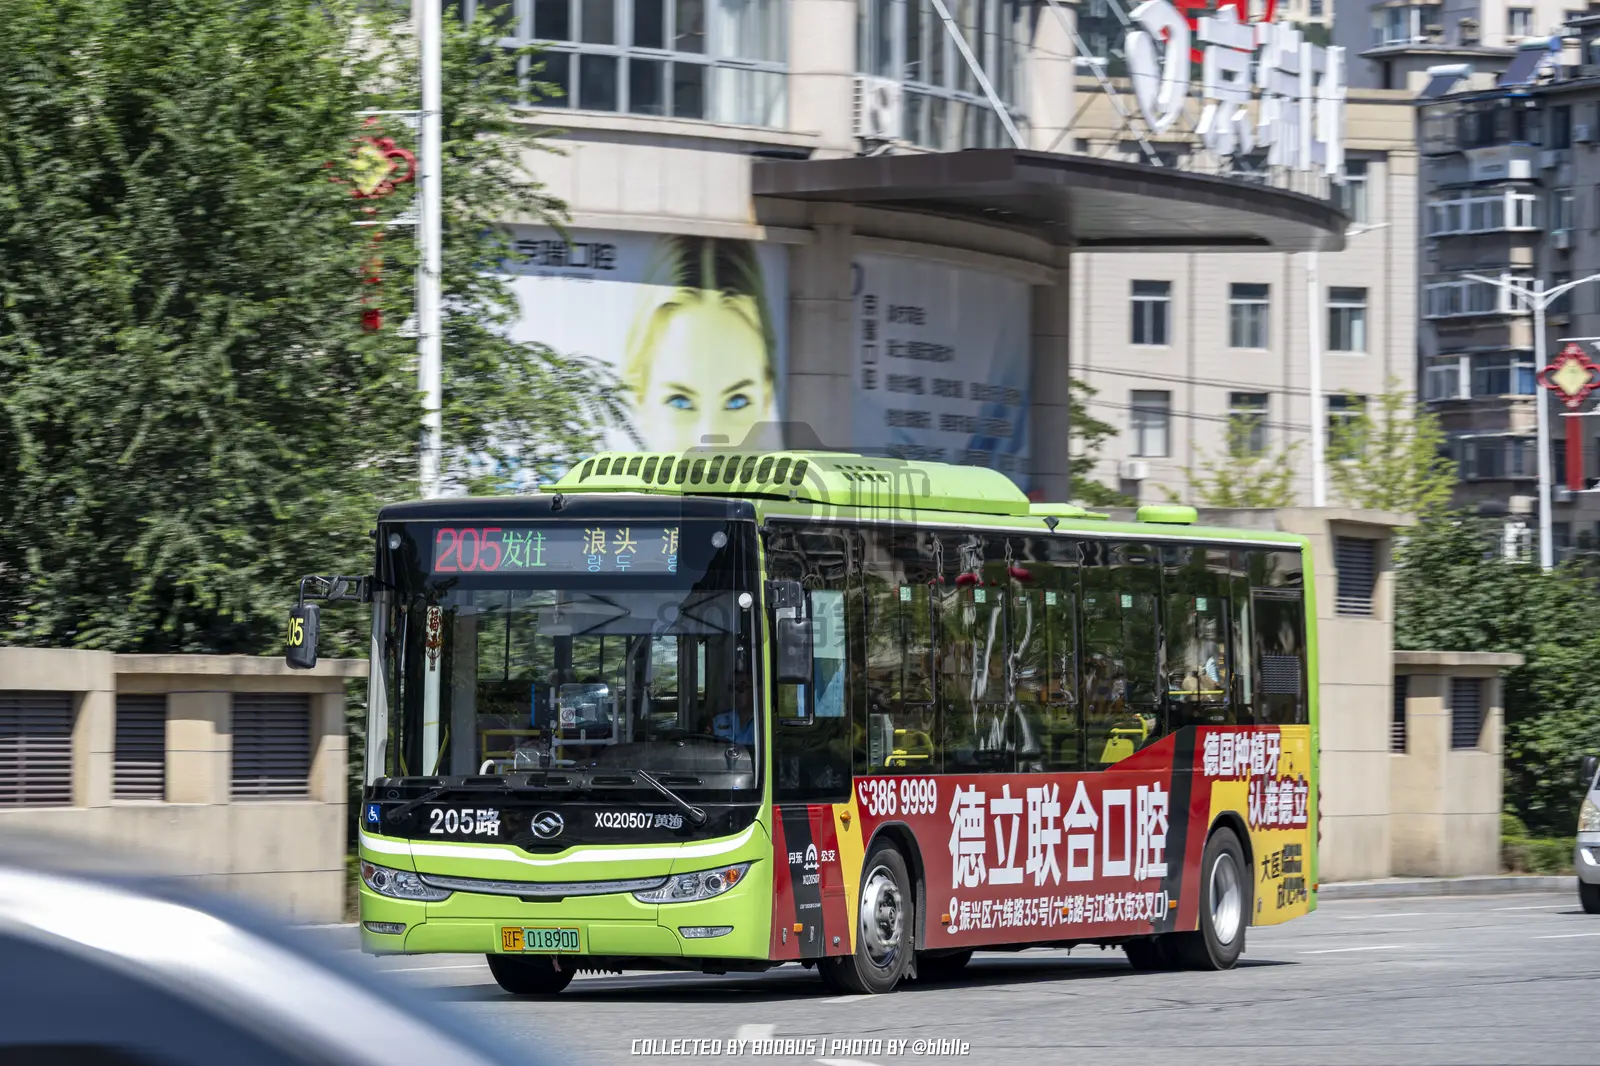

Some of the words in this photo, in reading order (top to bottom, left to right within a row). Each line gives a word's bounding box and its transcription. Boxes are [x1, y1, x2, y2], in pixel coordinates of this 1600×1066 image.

[435, 528, 502, 571] 205
[501, 531, 546, 568] 发往
[583, 527, 637, 554] 浪头
[287, 617, 304, 646] 05
[1203, 731, 1280, 776] 德国种植牙
[869, 779, 896, 816] 386
[901, 778, 937, 815] 9999
[1248, 774, 1308, 826] 认准德立
[429, 808, 501, 836] 205路
[595, 812, 653, 829] XQ20507
[949, 780, 1169, 889] 德立联合口腔
[788, 852, 803, 865] 丹东
[821, 850, 836, 862] 公交
